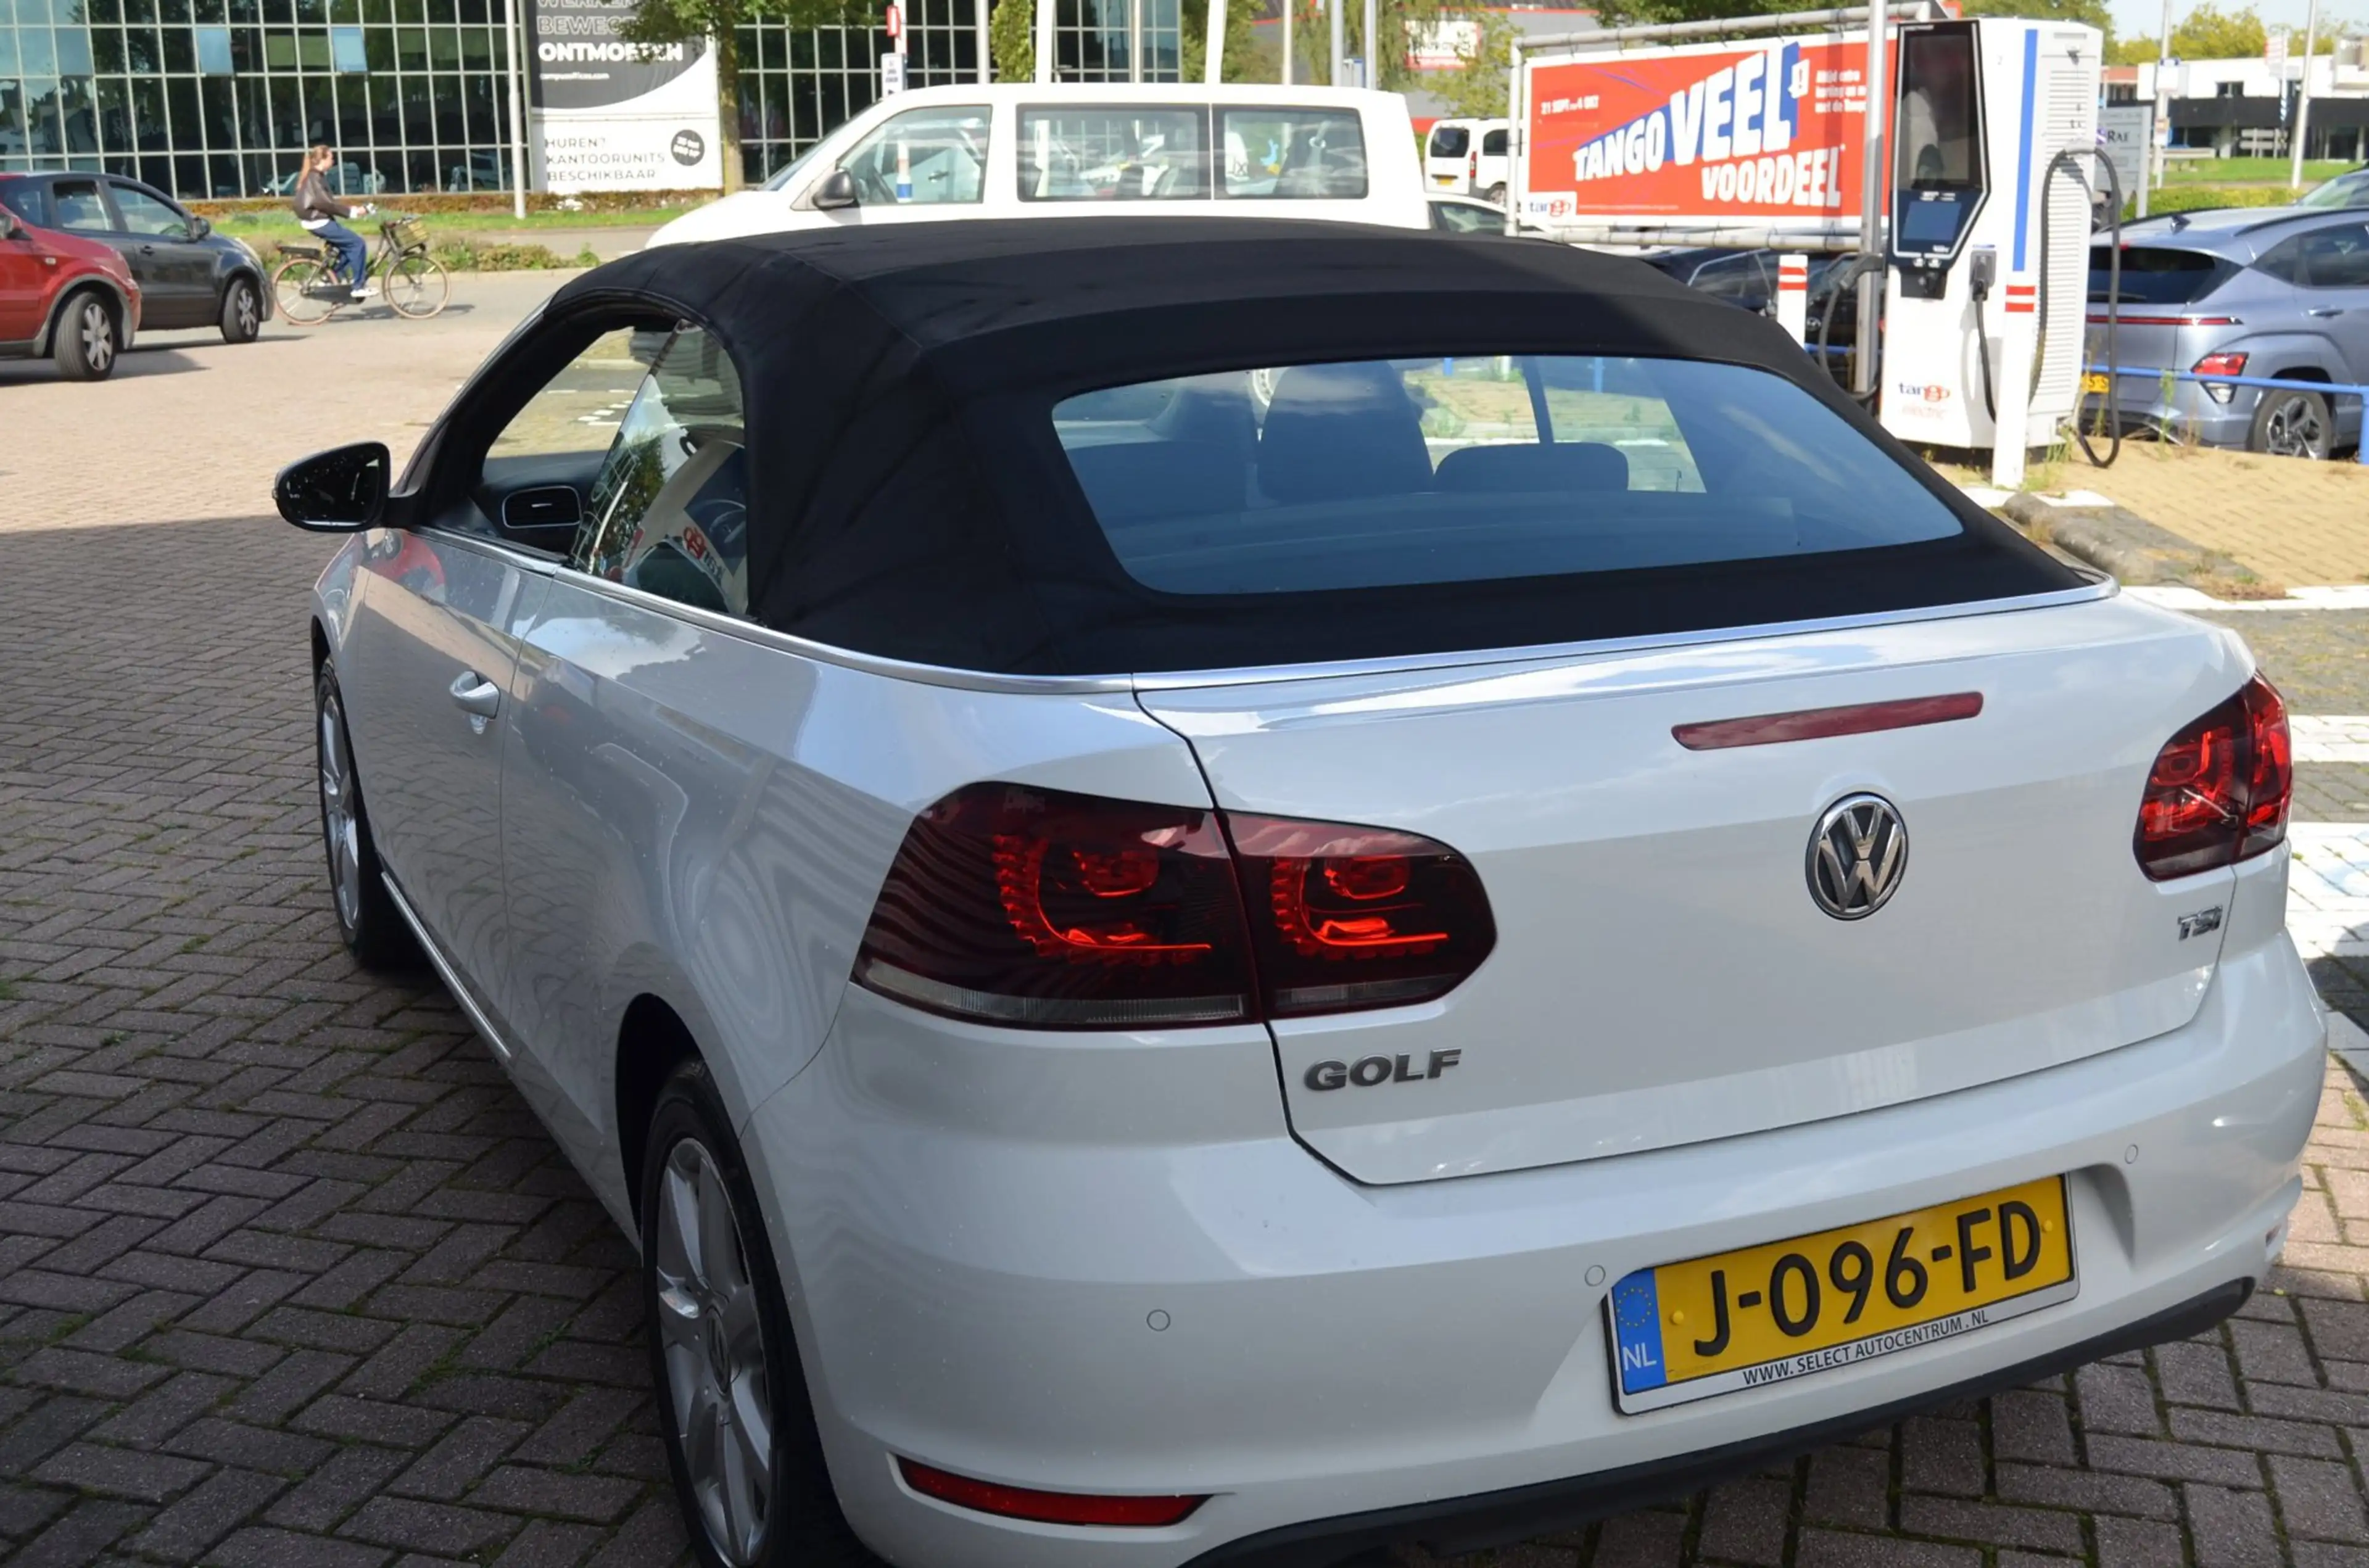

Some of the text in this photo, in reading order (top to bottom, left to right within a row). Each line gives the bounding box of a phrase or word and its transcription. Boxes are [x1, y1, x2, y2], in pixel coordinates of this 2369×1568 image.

[1573, 41, 1791, 181] TANGO VEEL
[1898, 382, 1950, 402] tango
[1304, 1047, 1462, 1091] GOLF
[1693, 1200, 2041, 1356] J-096-FD
[1623, 1342, 1656, 1371] NL
